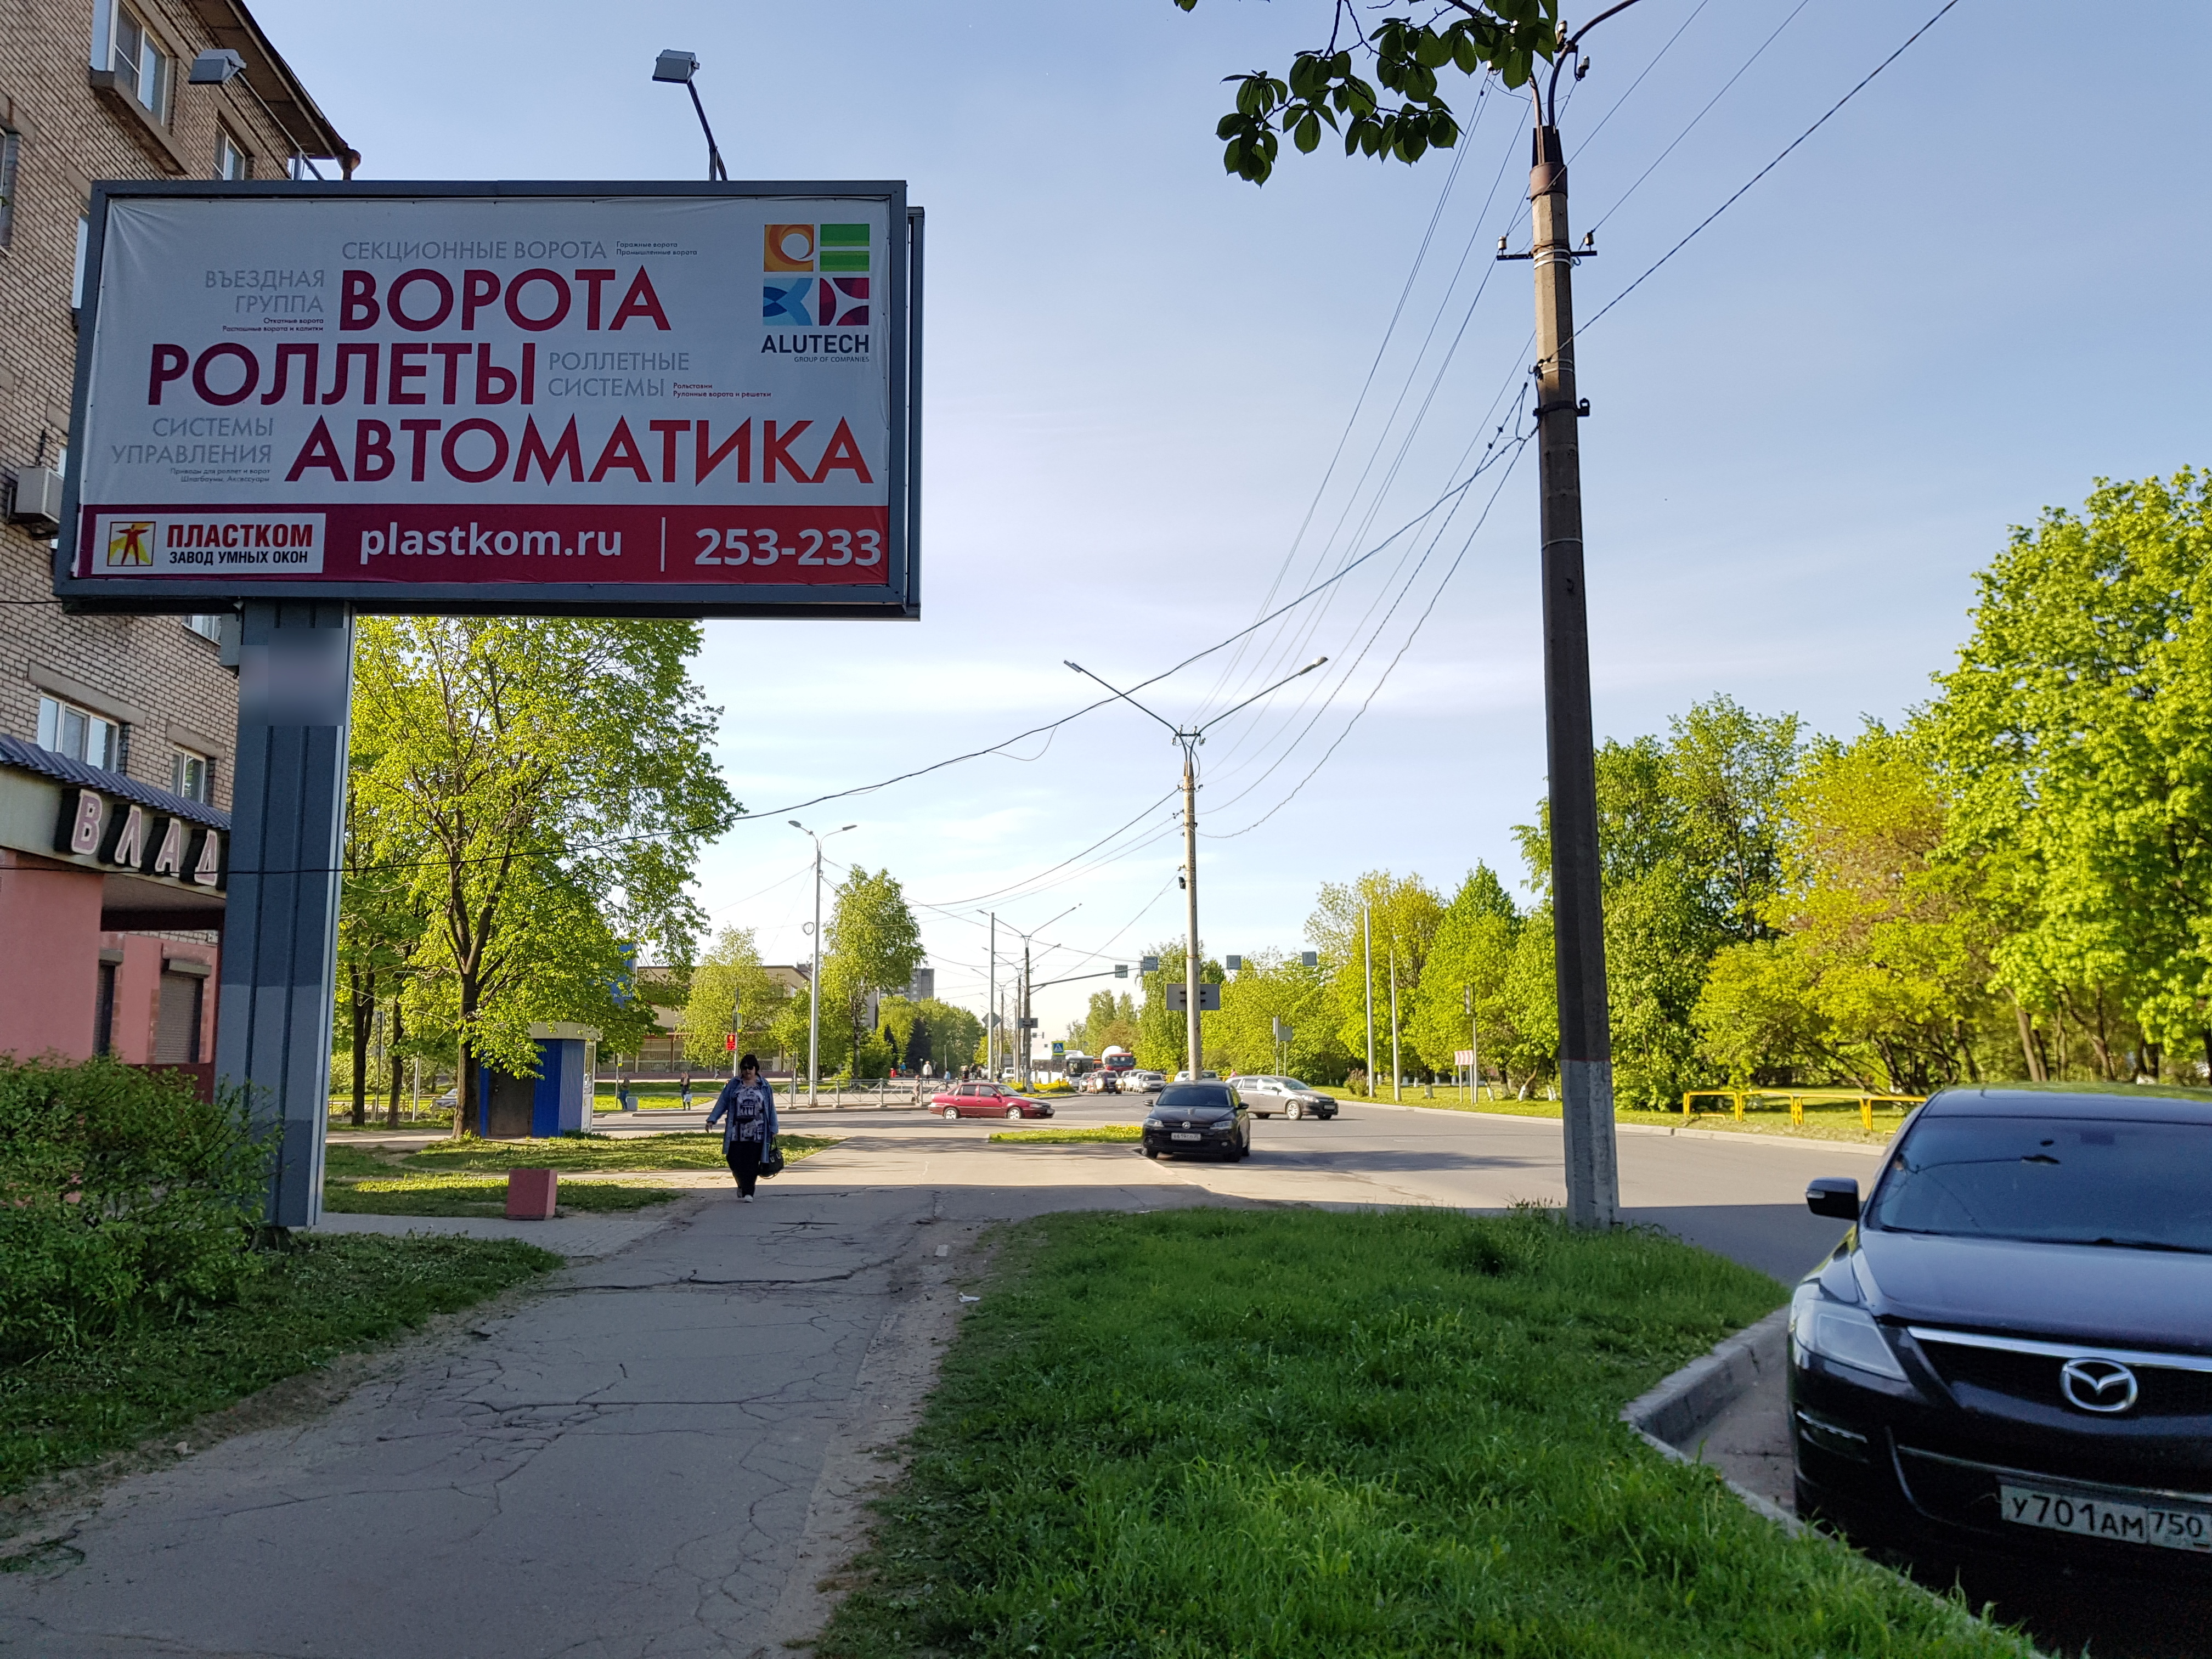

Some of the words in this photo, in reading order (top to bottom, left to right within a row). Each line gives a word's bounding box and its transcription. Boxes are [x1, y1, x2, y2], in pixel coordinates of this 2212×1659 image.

[342, 241, 506, 262] СЕКЦИОННЫЕ
[514, 241, 607, 259] ВОРОТА
[205, 269, 325, 291] ВЪЕЗДНАЯ
[235, 295, 324, 313] ГРУППА
[340, 264, 672, 332] ВОРОТА
[761, 334, 870, 354] ALUTECH
[549, 352, 690, 371] РОЛЛЕТНЫЕ
[148, 342, 535, 407] РОЛЛЕТЫ
[548, 378, 664, 397] СИСТЕМЫ
[153, 417, 274, 437] СИСТЕМЫ
[111, 444, 272, 464] УПРАВЛЕНИЯ
[284, 413, 874, 487] АВТОМАТИКА
[166, 524, 313, 548] ПЛАСТКОМ
[359, 522, 622, 565] plastkom.ru
[694, 528, 882, 566] 253-233
[169, 551, 214, 566] ЗАВОД
[218, 551, 268, 564] УМНЫХ
[273, 550, 308, 563] ОКОН
